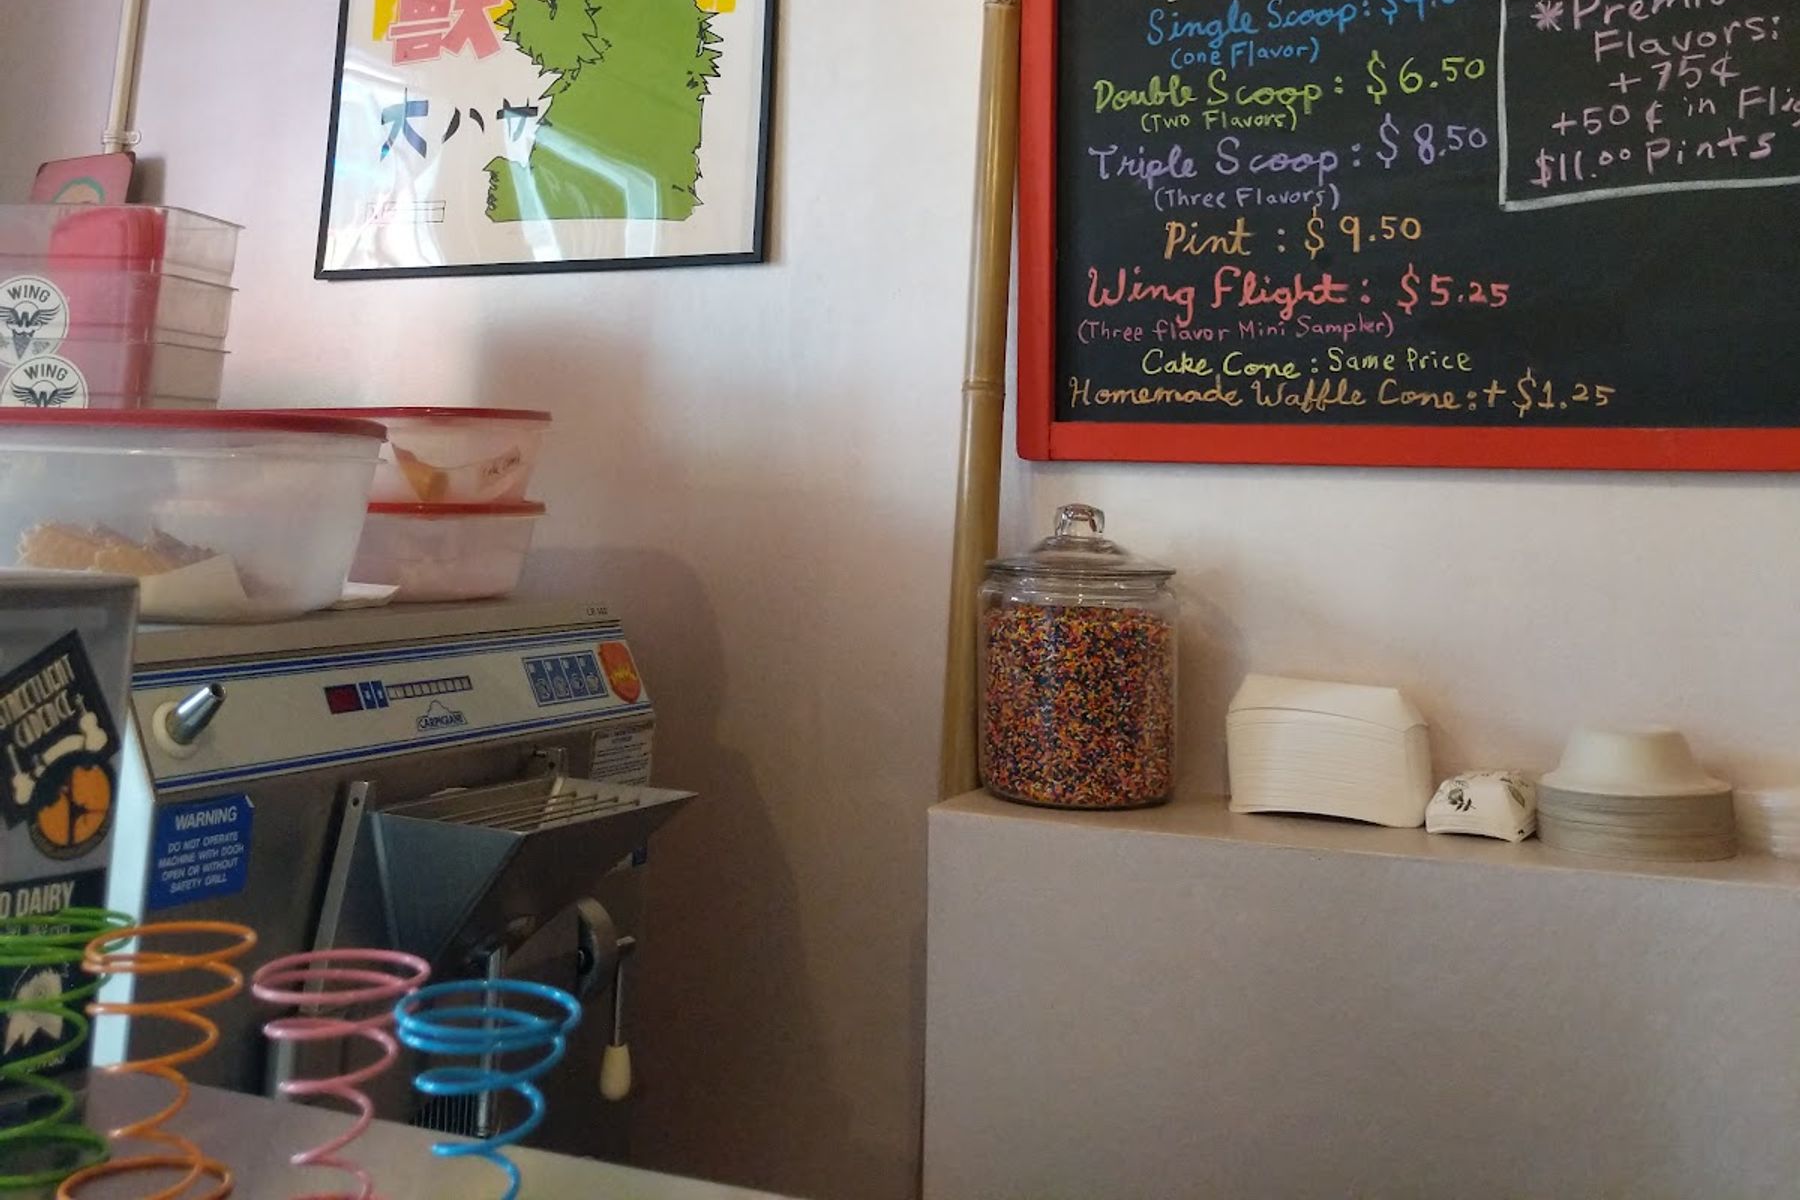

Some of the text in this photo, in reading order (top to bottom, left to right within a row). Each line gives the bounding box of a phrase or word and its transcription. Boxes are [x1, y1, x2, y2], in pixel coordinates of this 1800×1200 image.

[1170, 36, 1321, 71] (one Flavor)
[1092, 73, 1198, 114] Double
[1683, 96, 1717, 118] in
[1140, 104, 1298, 134] (Two Flavors)
[1087, 143, 1198, 190] Triple
[1153, 183, 1341, 212] (Three Flavors)
[6, 282, 52, 304] WING
[1087, 265, 1196, 328] Wing
[1396, 261, 1511, 316] $5.25
[1077, 318, 1144, 344] (Three
[1238, 319, 1286, 340] Mini
[1295, 312, 1394, 343] Sampler)
[23, 362, 70, 382] WING
[1141, 348, 1213, 376] Cake
[1327, 346, 1395, 372] Same
[1406, 346, 1473, 372] Price
[1068, 373, 1244, 409] Homemade
[1250, 376, 1367, 413] Waffle
[174, 805, 238, 832] WARNING
[168, 831, 240, 854] DO NOT OPERATE
[158, 852, 197, 869] MACHINE
[197, 848, 220, 861] WITH
[161, 856, 239, 881] OPEN OR WITHOUT
[15, 879, 76, 918] DAIRY
[169, 878, 203, 894] SAFETY
